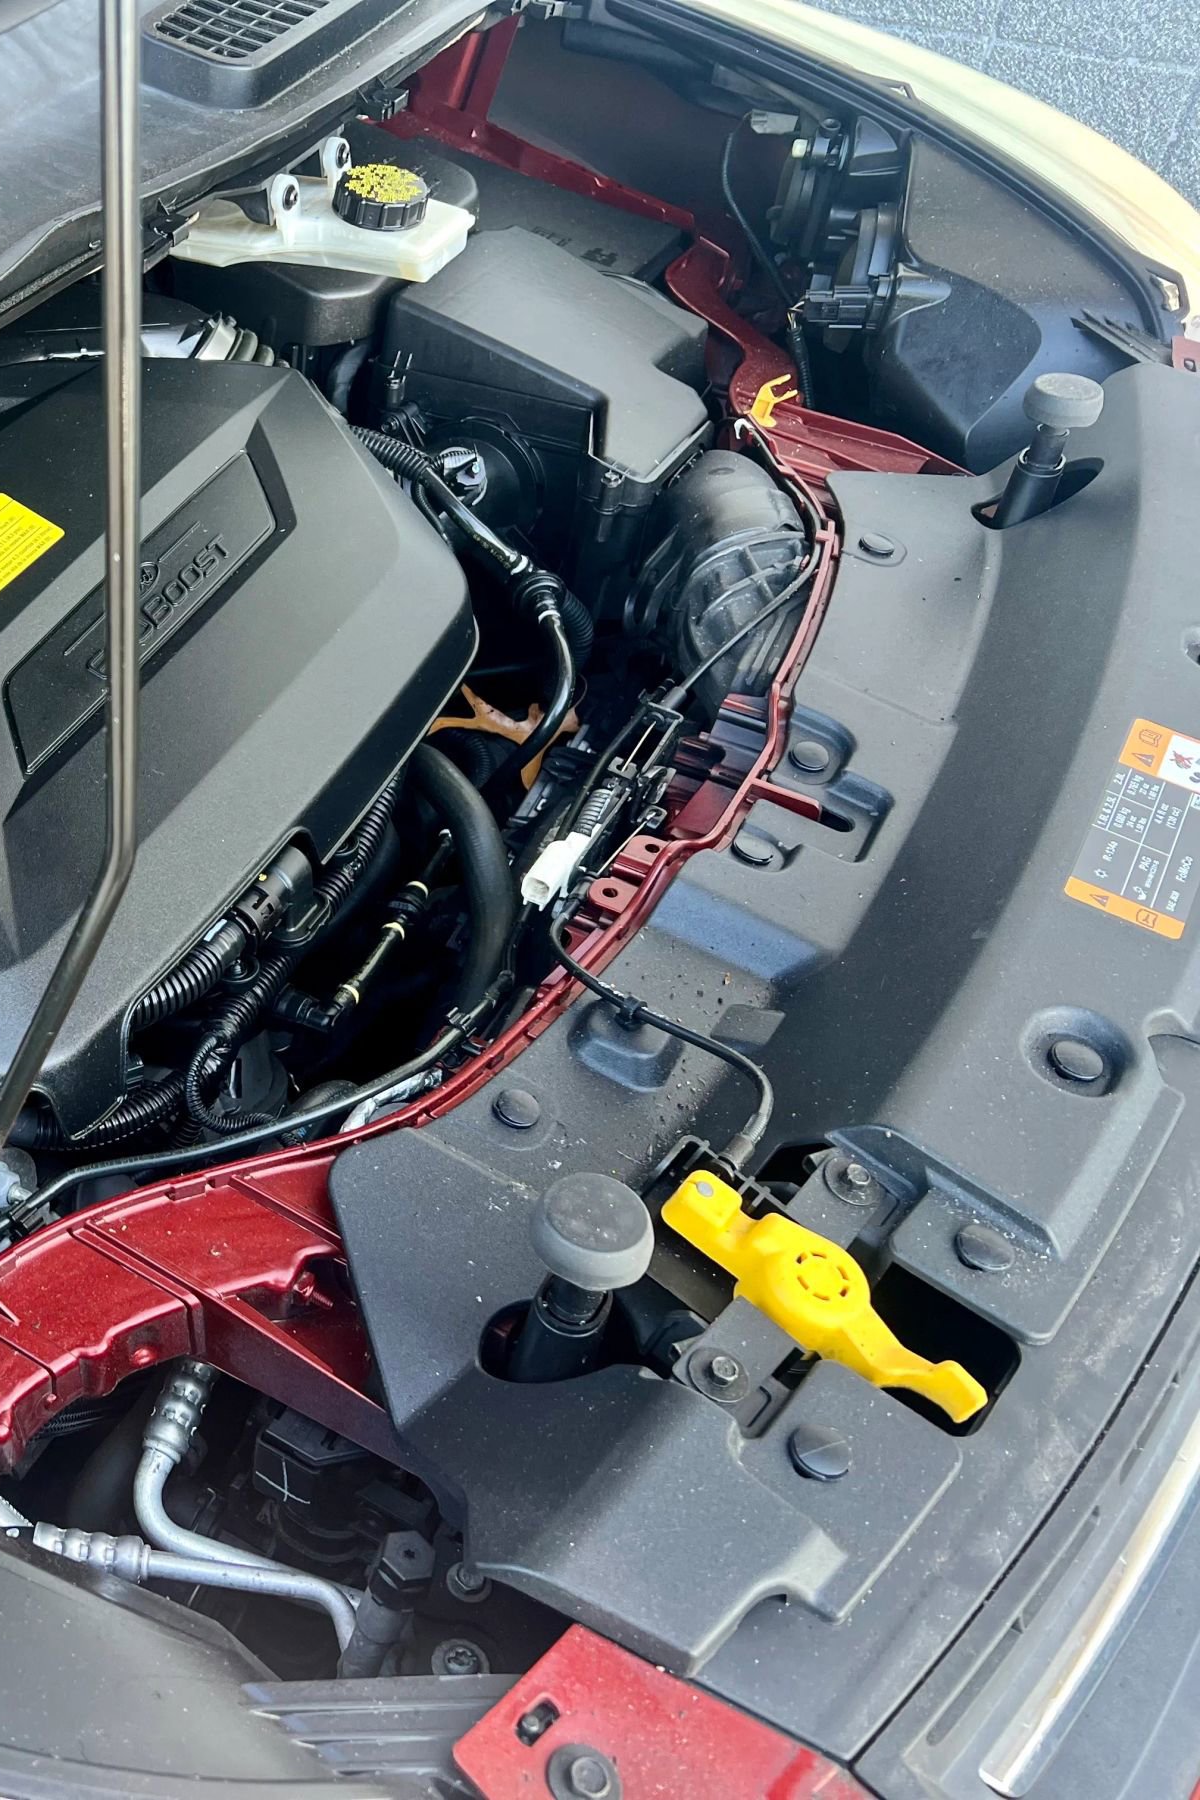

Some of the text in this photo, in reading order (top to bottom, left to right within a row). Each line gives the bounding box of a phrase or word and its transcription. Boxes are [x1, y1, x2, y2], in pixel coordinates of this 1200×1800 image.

[1101, 838, 1119, 862] R-134a
[1137, 854, 1152, 872] PAG
[1173, 853, 1195, 883] FoMoCo
